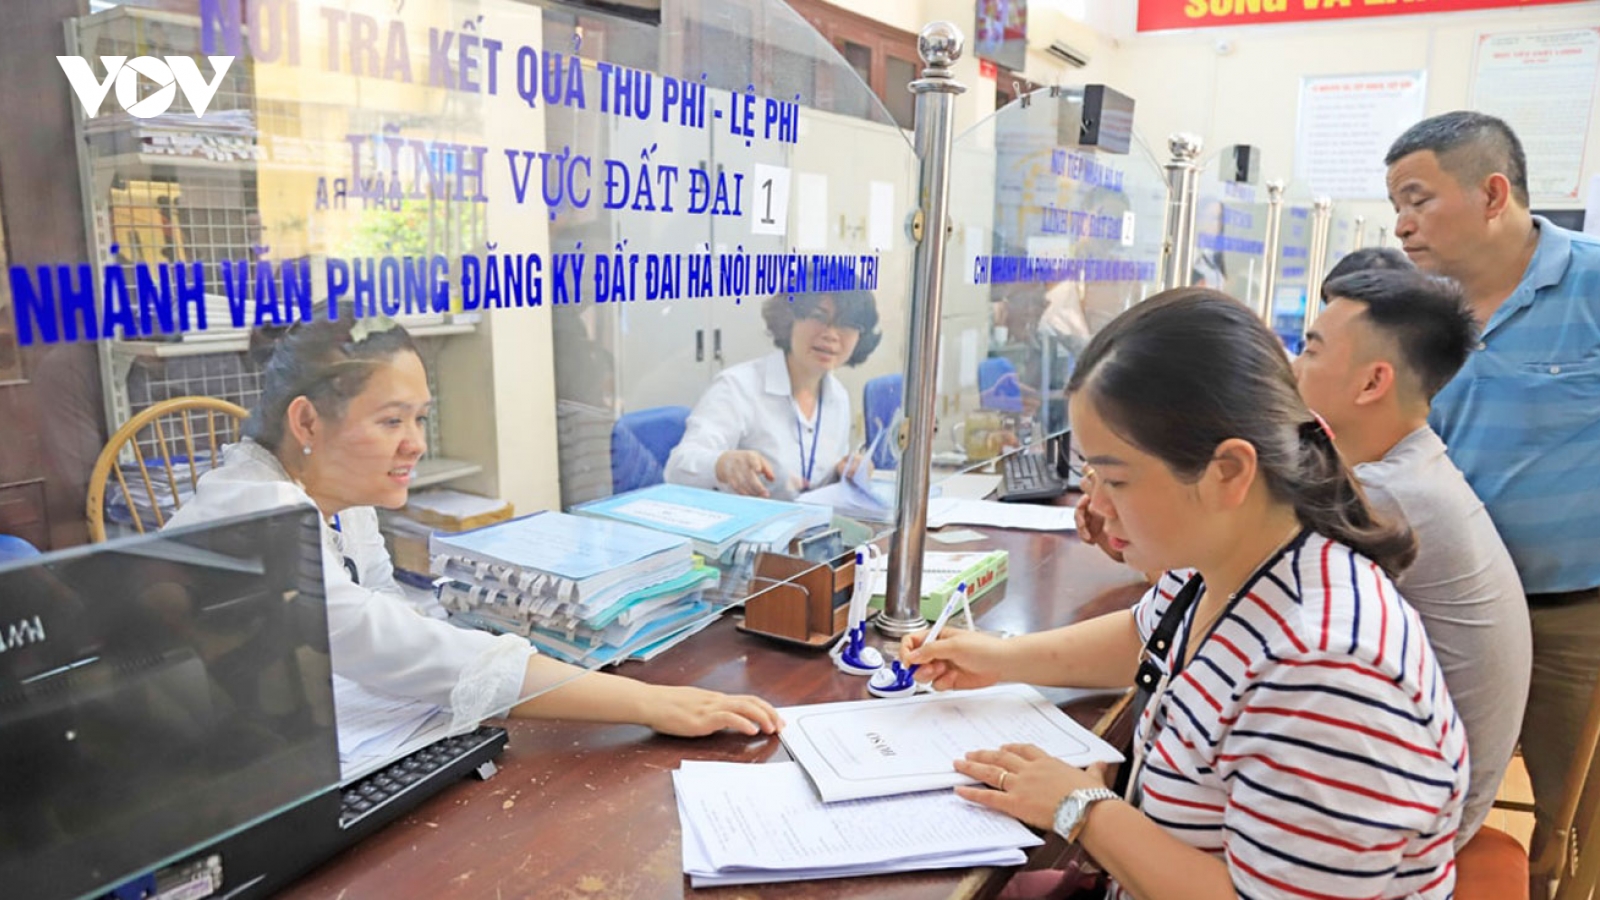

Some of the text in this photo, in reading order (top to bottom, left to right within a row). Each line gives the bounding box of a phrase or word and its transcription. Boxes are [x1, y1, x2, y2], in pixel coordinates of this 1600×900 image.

[429, 15, 503, 95] KẾT
[517, 33, 586, 109] QUẢ
[597, 62, 653, 120] THU
[662, 73, 707, 129] PHÍ
[730, 84, 756, 147] LỆ
[765, 94, 800, 144] PHÍ
[345, 123, 744, 221] LĨNH VỰC ĐẤT ĐAI
[761, 178, 775, 225] 1
[221, 245, 312, 329] VĂN
[462, 241, 542, 311] ĐĂNG
[552, 241, 585, 305] KÝ
[594, 238, 639, 303] ĐẤT
[646, 253, 681, 301] ĐAI
[688, 242, 713, 298] HÀ
[719, 245, 750, 305] NỘI
[755, 246, 807, 302] HUYỆN
